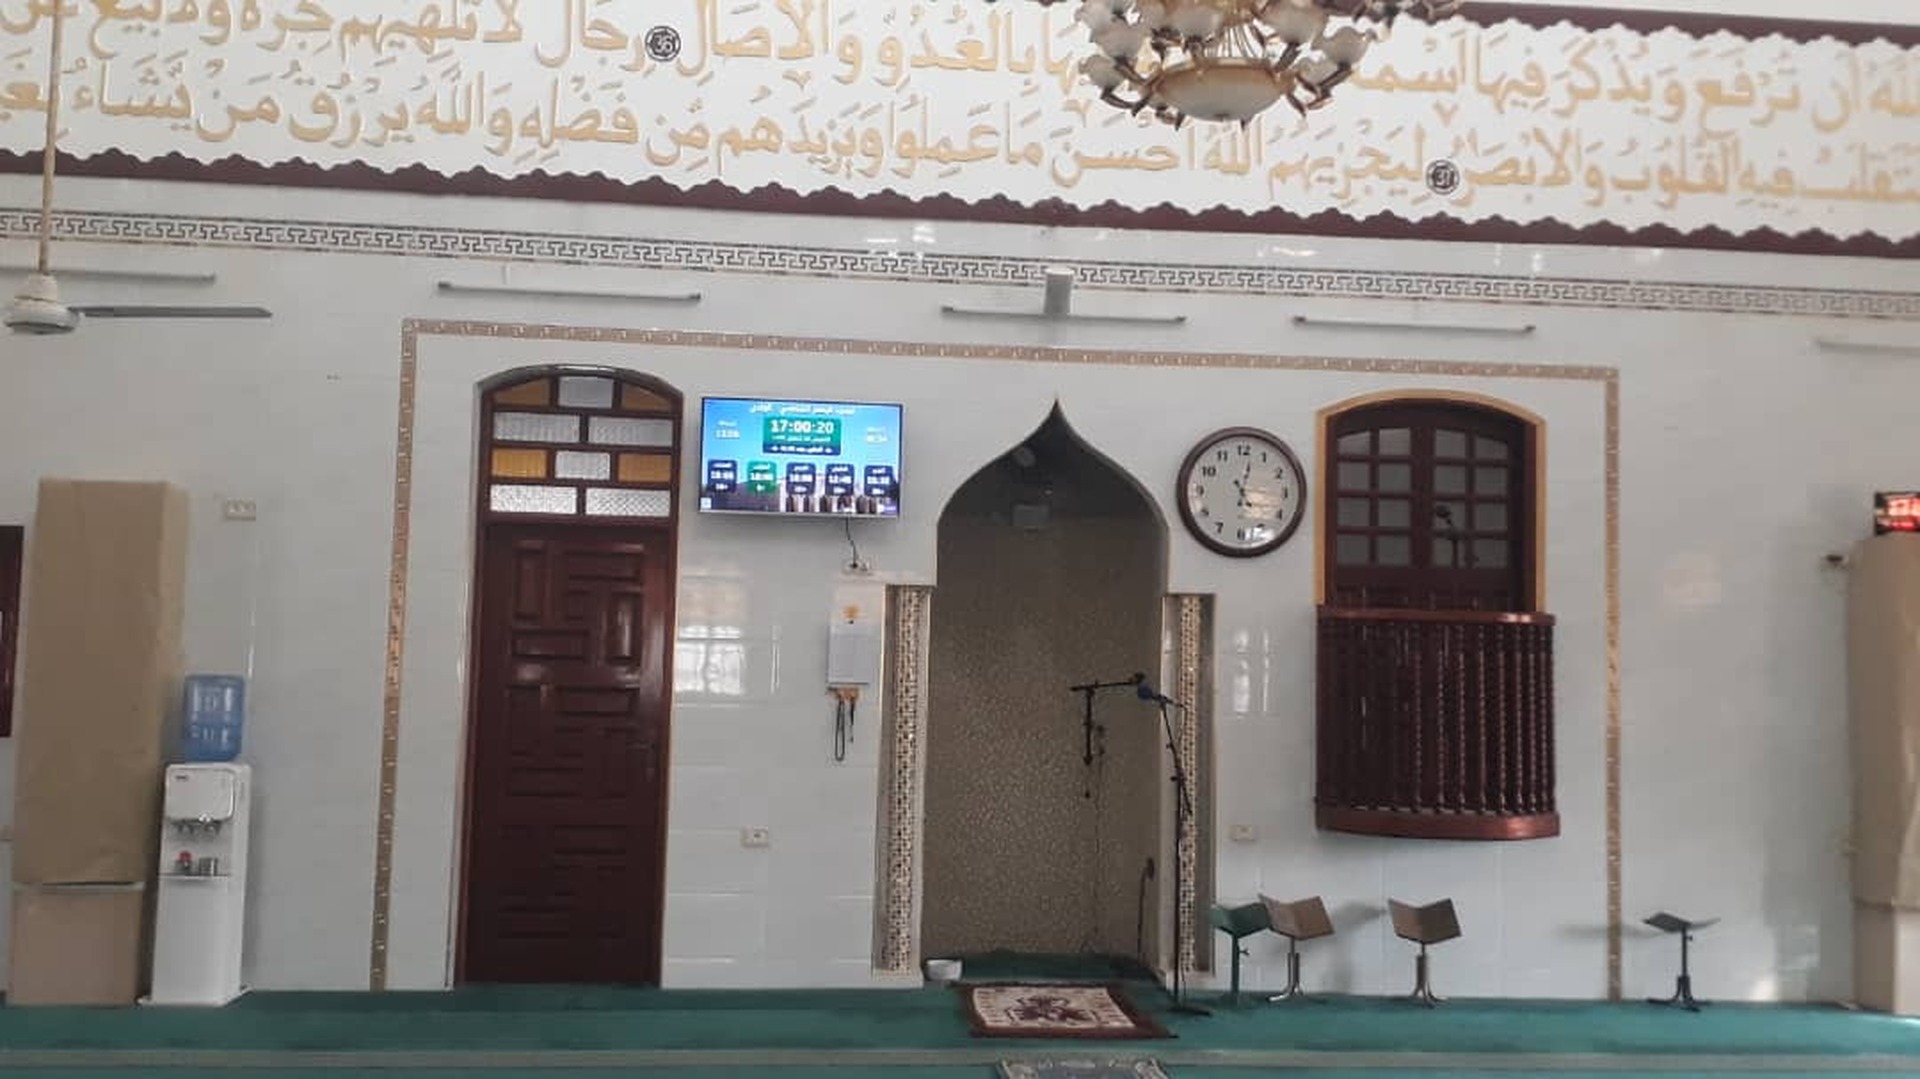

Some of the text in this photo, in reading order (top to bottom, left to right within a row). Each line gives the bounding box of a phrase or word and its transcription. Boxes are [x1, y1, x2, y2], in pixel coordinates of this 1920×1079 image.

[771, 419, 834, 434] 17:00:20
[1237, 445, 1251, 456] 12
[1217, 451, 1228, 462] 11
[1201, 466, 1216, 477] 10
[1275, 469, 1283, 479] 2
[1215, 522, 1224, 533] 7
